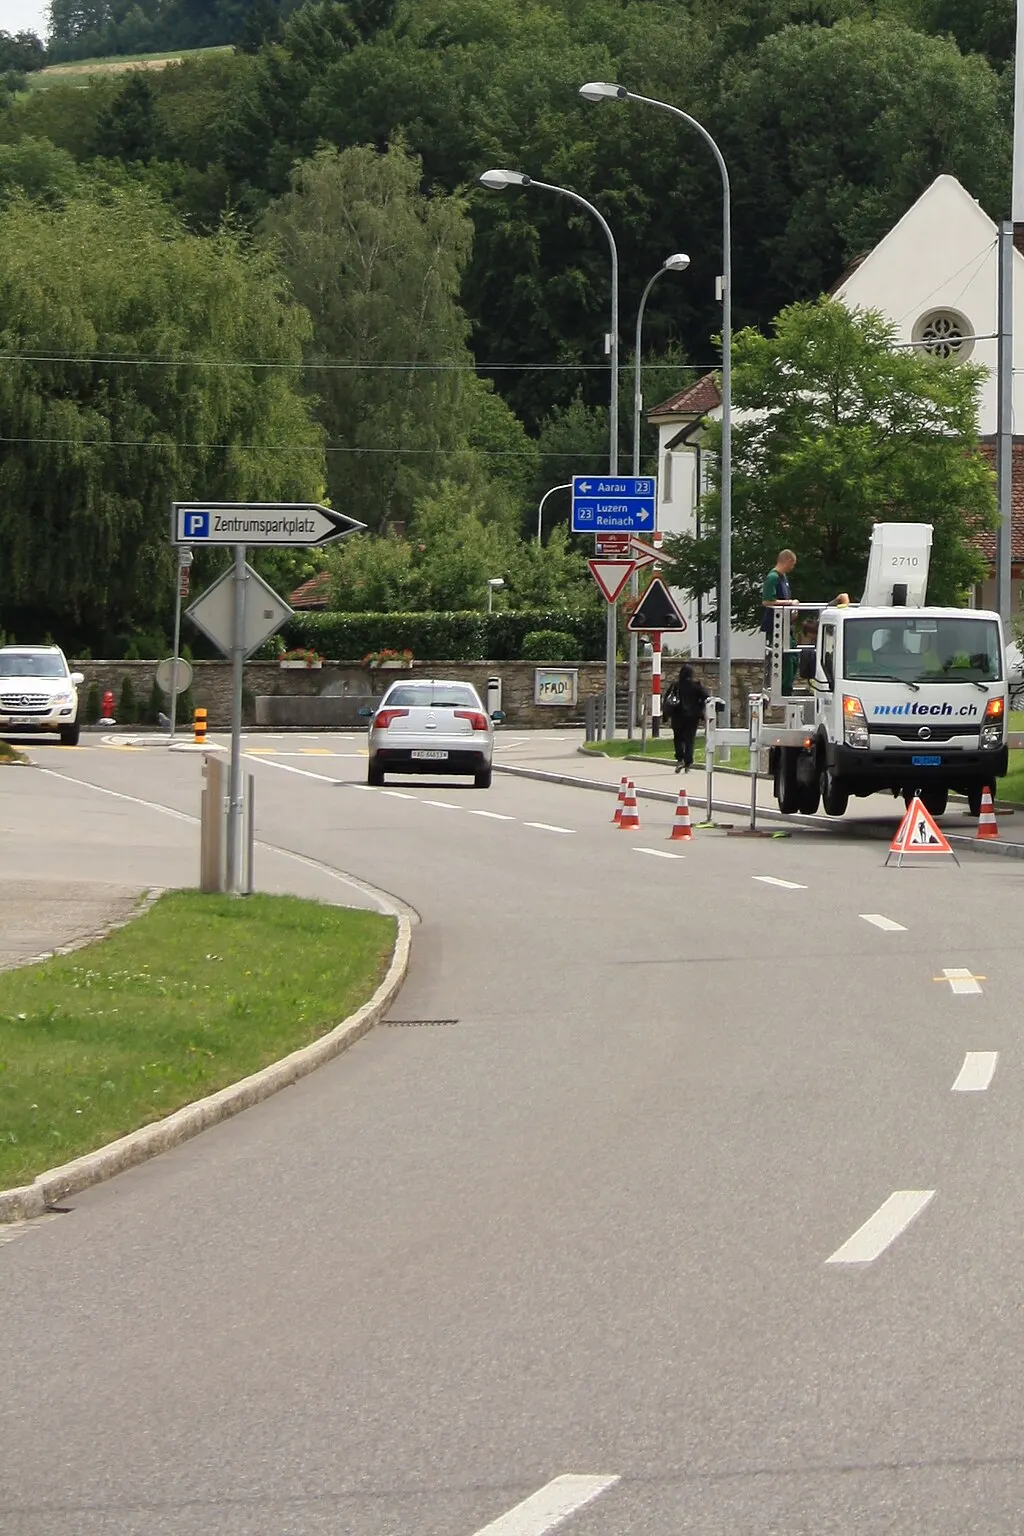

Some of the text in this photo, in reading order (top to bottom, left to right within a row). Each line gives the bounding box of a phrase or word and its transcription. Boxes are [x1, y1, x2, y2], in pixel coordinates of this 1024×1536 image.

[598, 483, 648, 492] Aarau 23
[597, 503, 628, 513] Luzern
[580, 510, 591, 518] 23
[191, 516, 315, 536] P Zentrumsparkplatz
[597, 516, 634, 526] Reinach
[891, 557, 918, 567] 2710
[873, 701, 978, 716] maltech.ch
